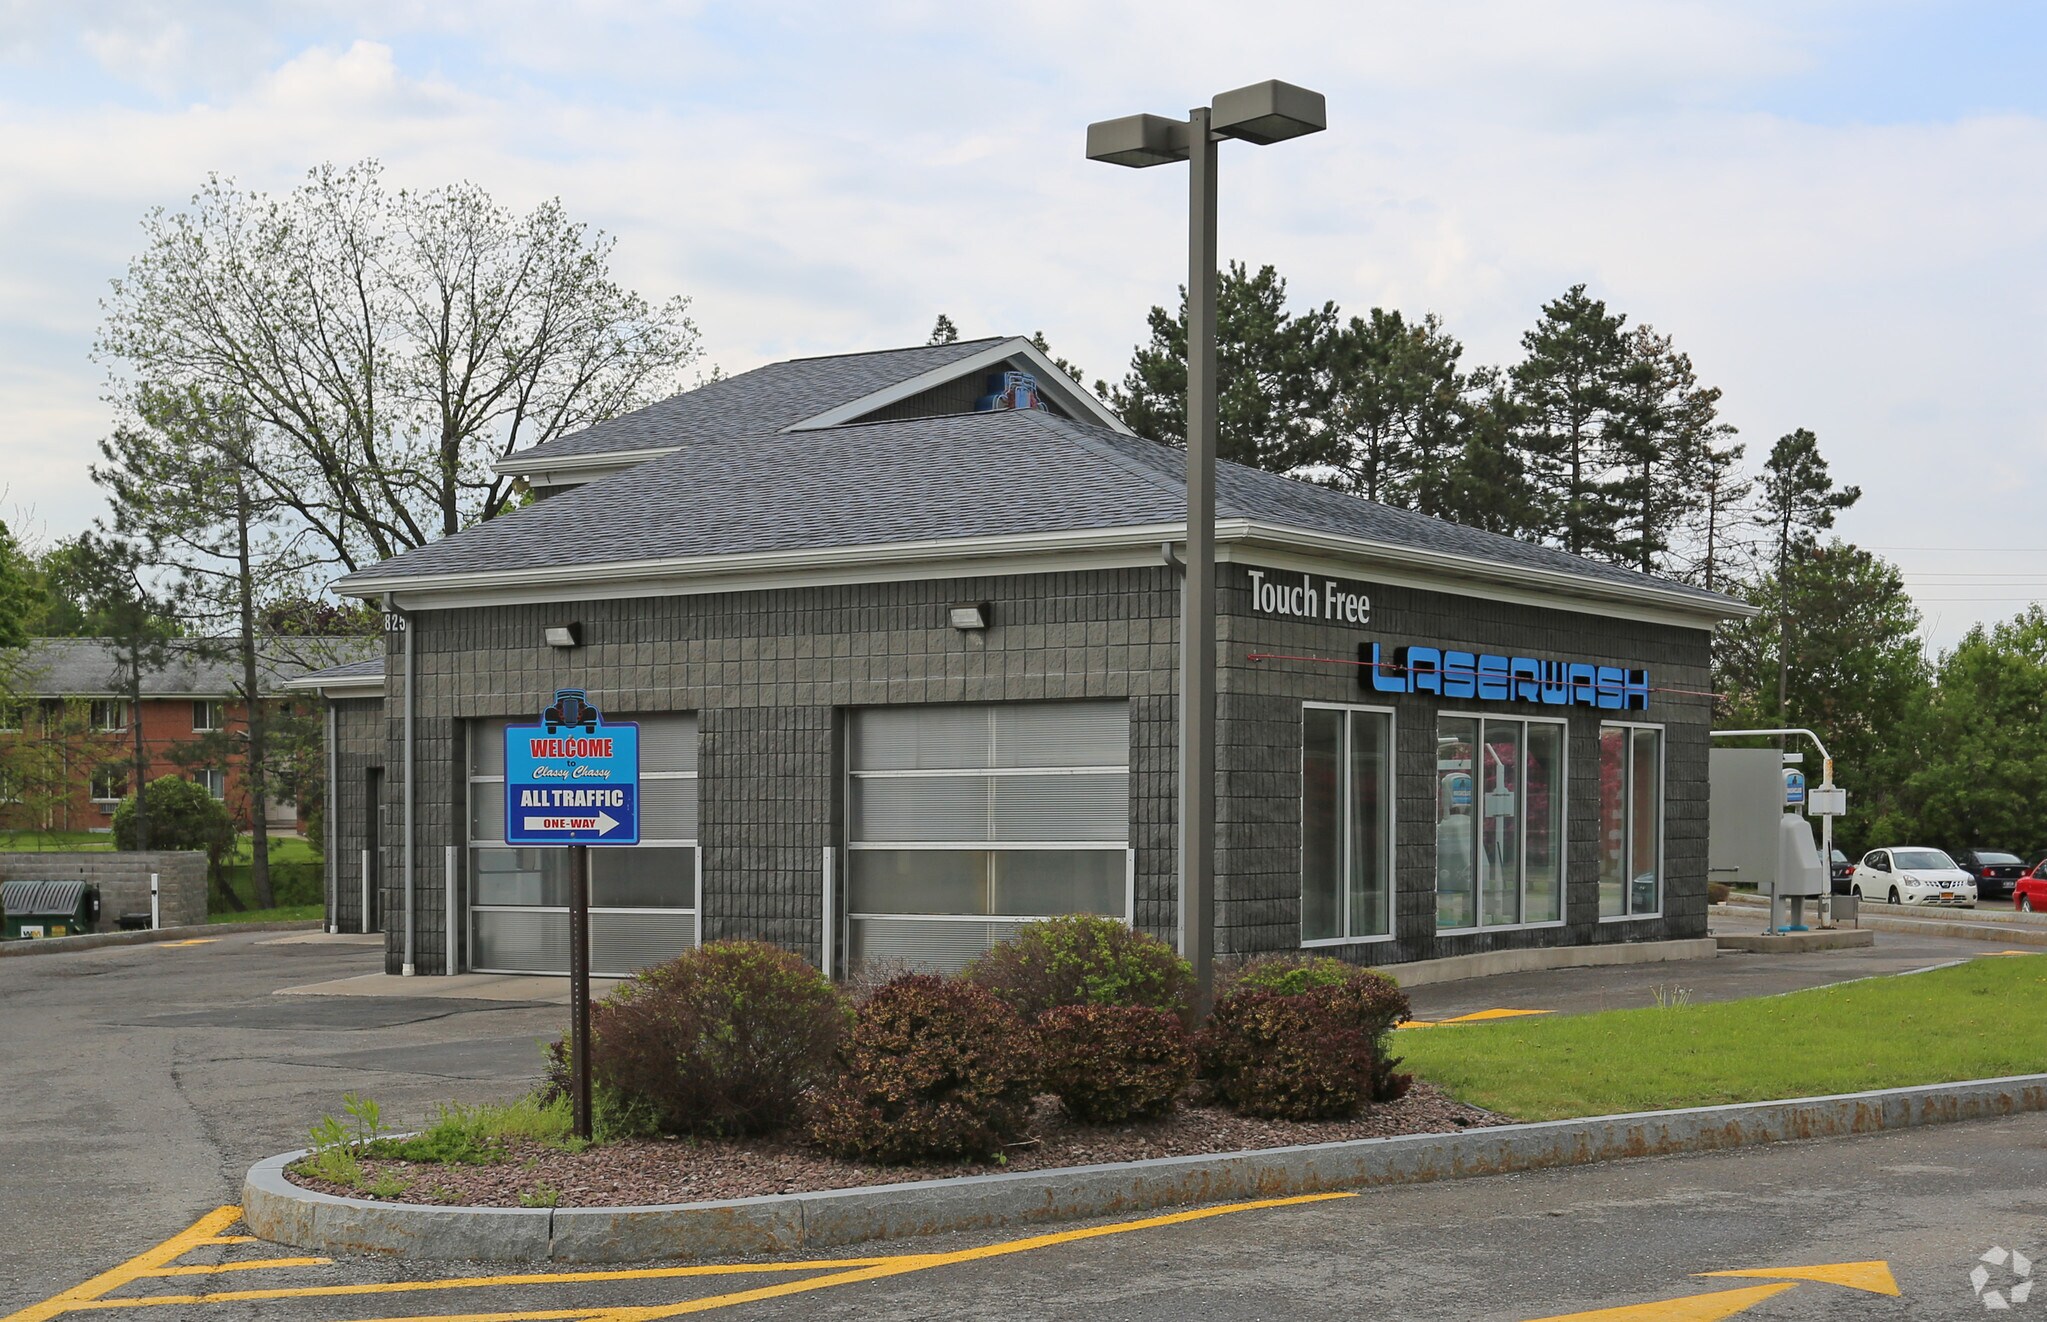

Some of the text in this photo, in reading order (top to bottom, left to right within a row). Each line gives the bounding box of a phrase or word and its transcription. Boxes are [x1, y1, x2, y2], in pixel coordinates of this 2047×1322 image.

[1248, 570, 1370, 623] Touch Free
[385, 614, 405, 631] 825
[1371, 642, 1648, 710] LASERWASH
[530, 738, 613, 758] WELCOME
[532, 765, 611, 780] Classy Chassy
[520, 790, 624, 807] ALL TRAFFIC
[543, 819, 596, 829] ONE-WAY
